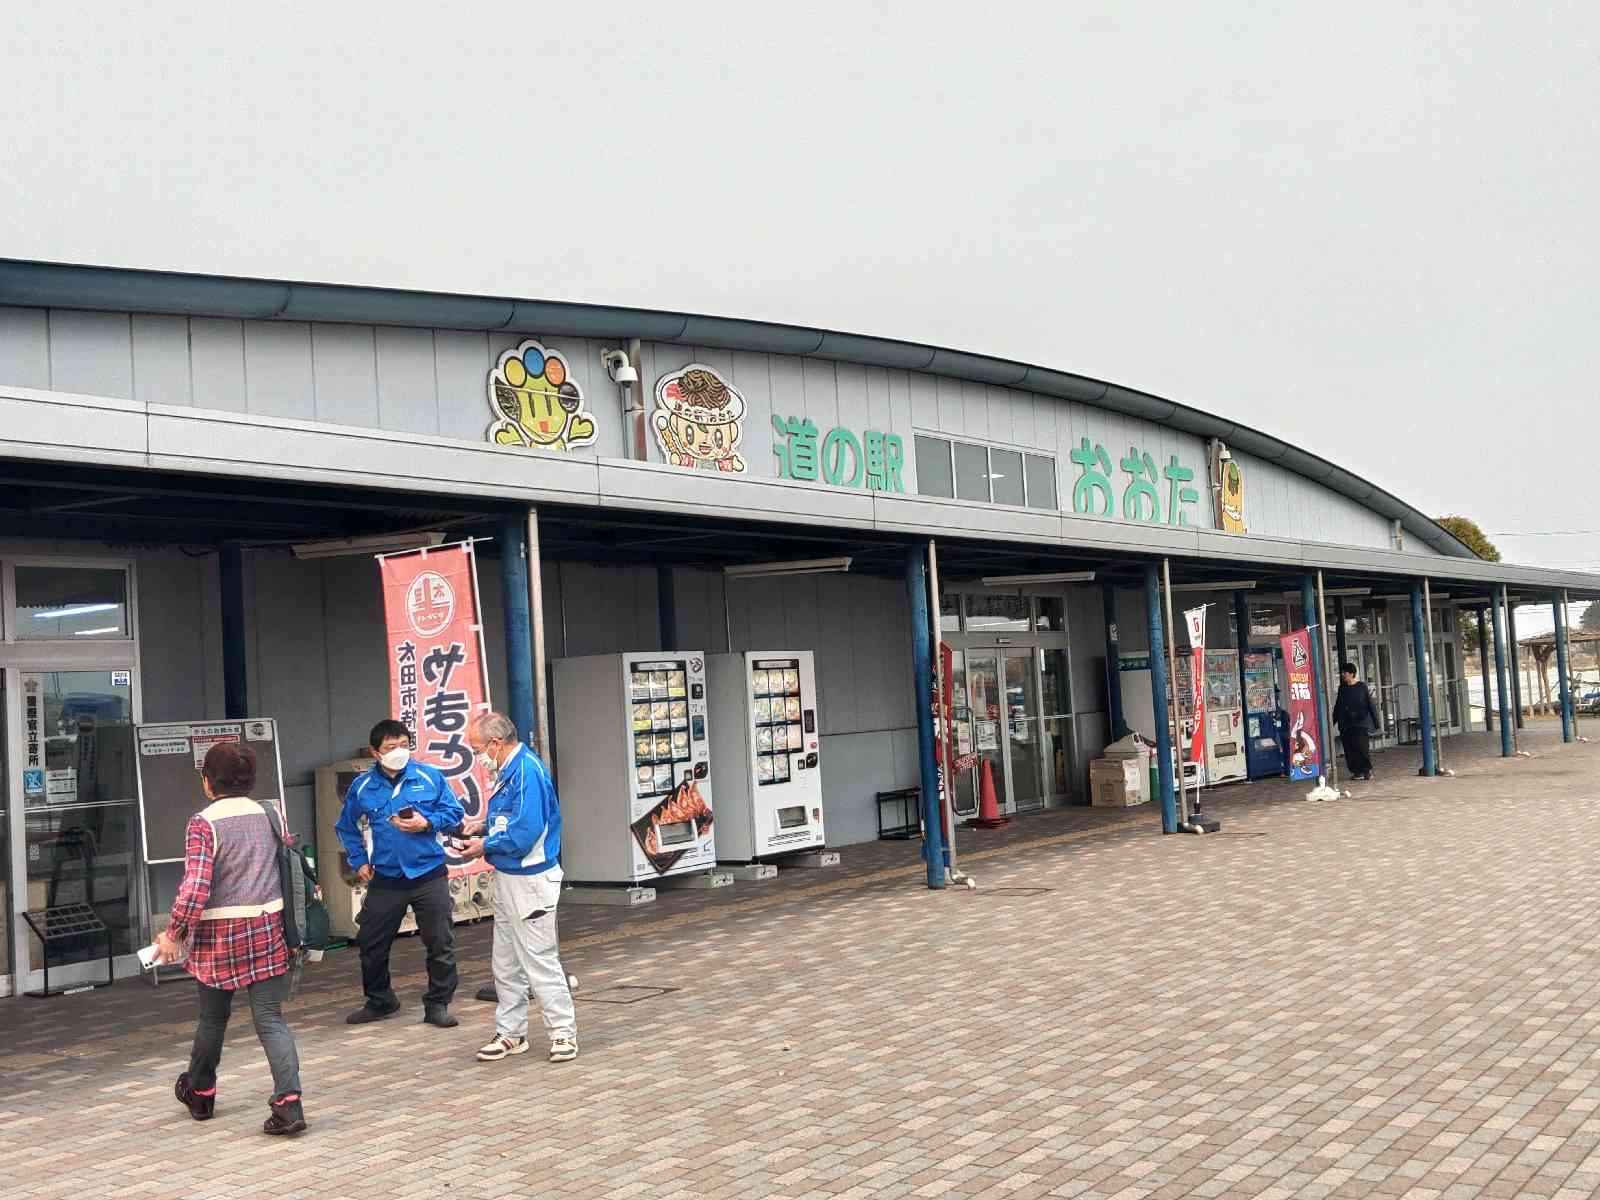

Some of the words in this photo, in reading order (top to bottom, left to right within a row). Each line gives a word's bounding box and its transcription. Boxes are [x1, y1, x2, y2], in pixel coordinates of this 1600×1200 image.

[772, 414, 905, 494] 道の駅
[1071, 437, 1199, 526] おおた
